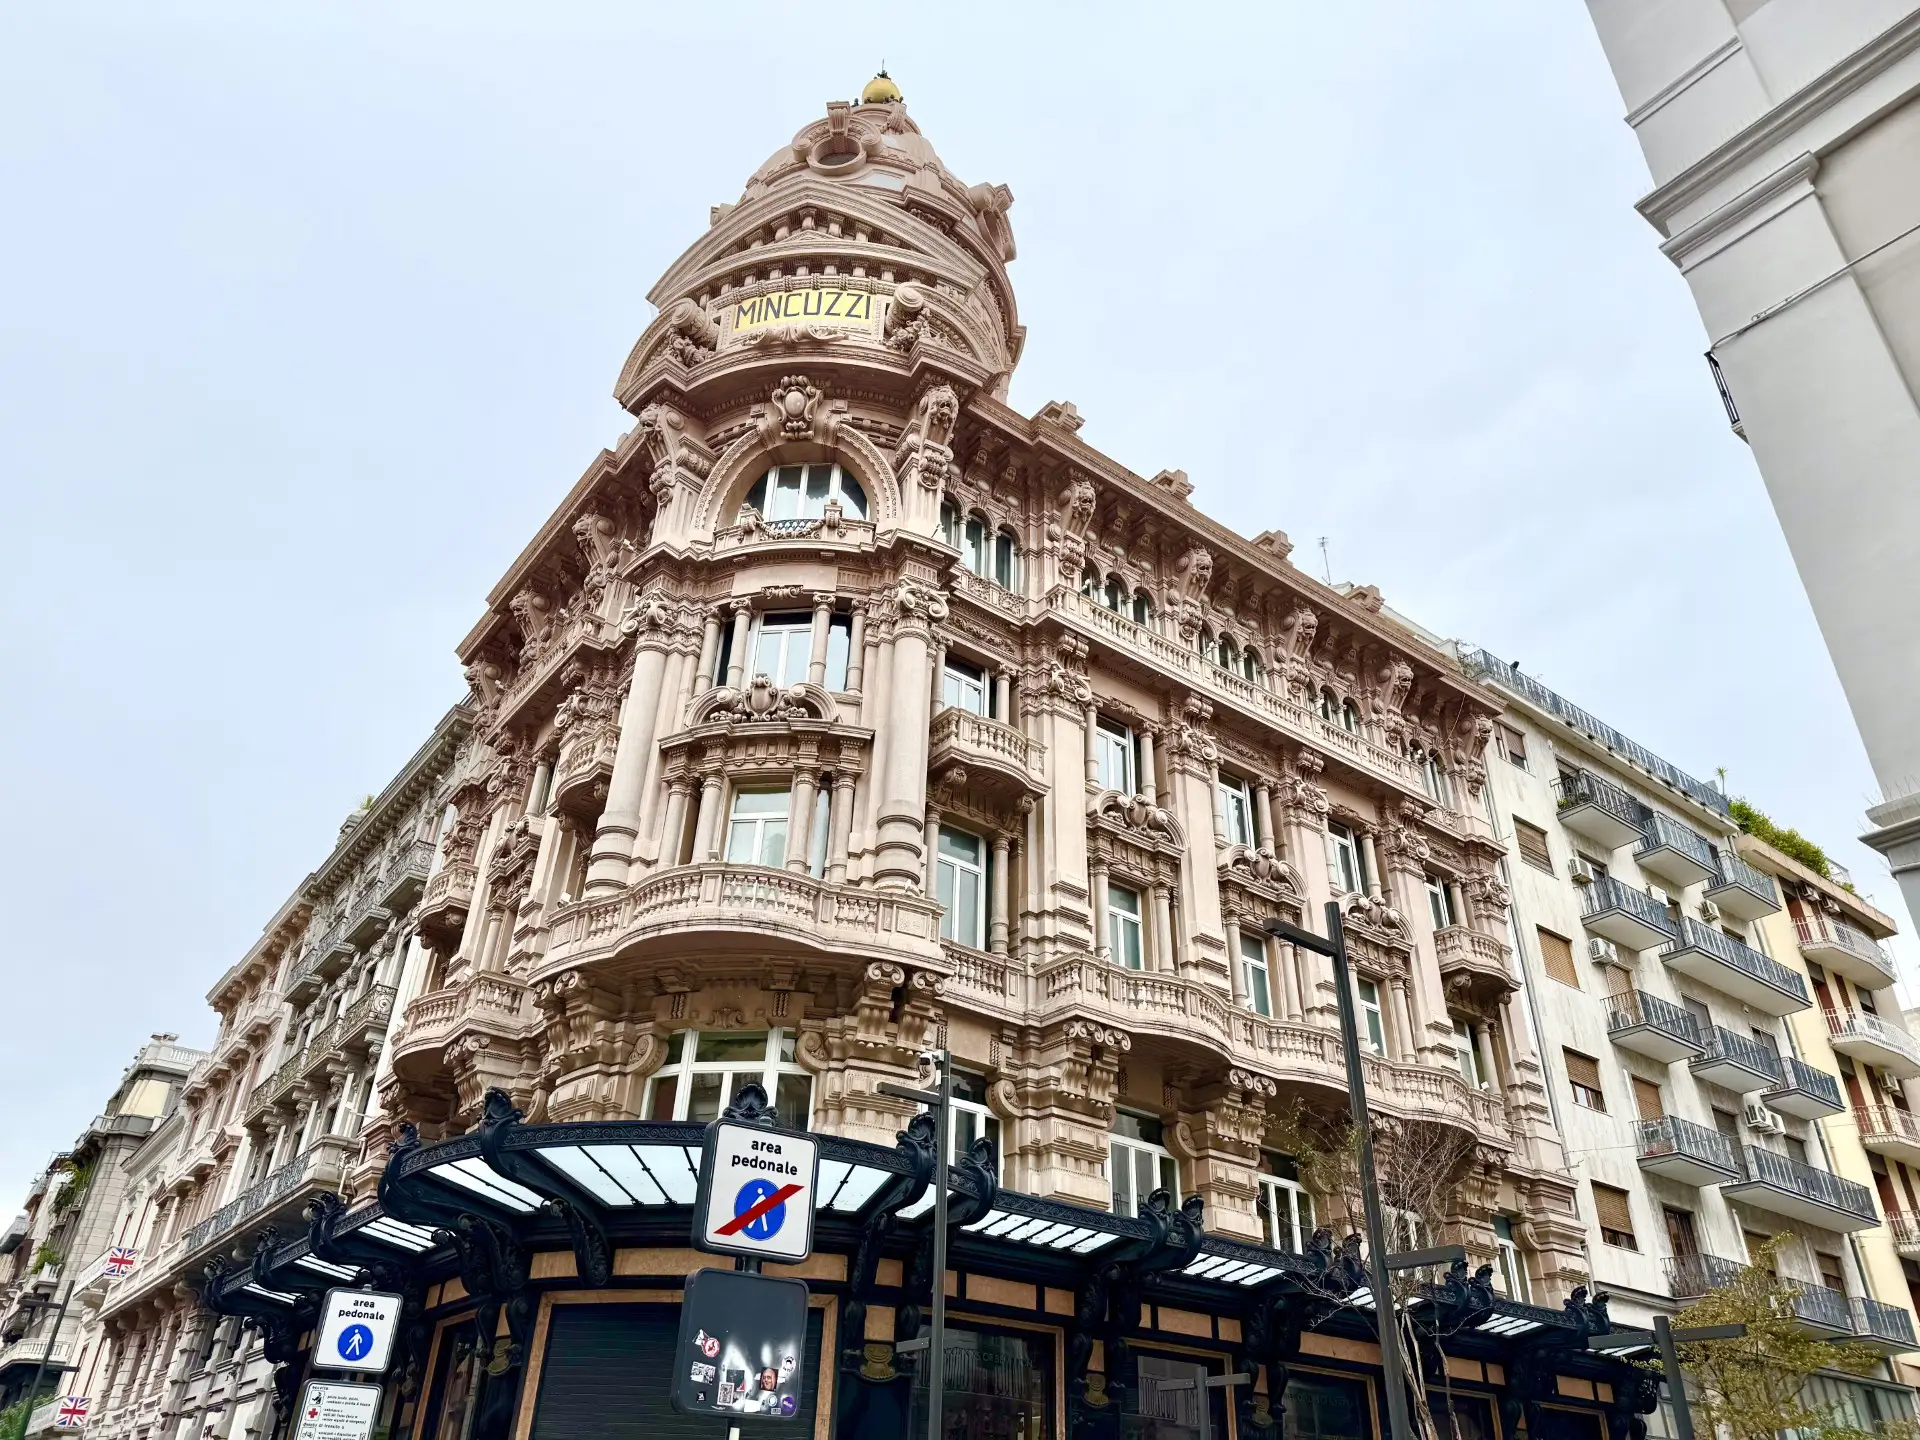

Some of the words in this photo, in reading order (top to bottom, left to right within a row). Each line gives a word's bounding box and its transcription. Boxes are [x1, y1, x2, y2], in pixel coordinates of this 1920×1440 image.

[735, 291, 871, 329] MINCUZZI
[751, 1140, 782, 1155] area
[731, 1155, 798, 1175] pedonale
[353, 1299, 375, 1308] area
[338, 1309, 385, 1320] pedonale
